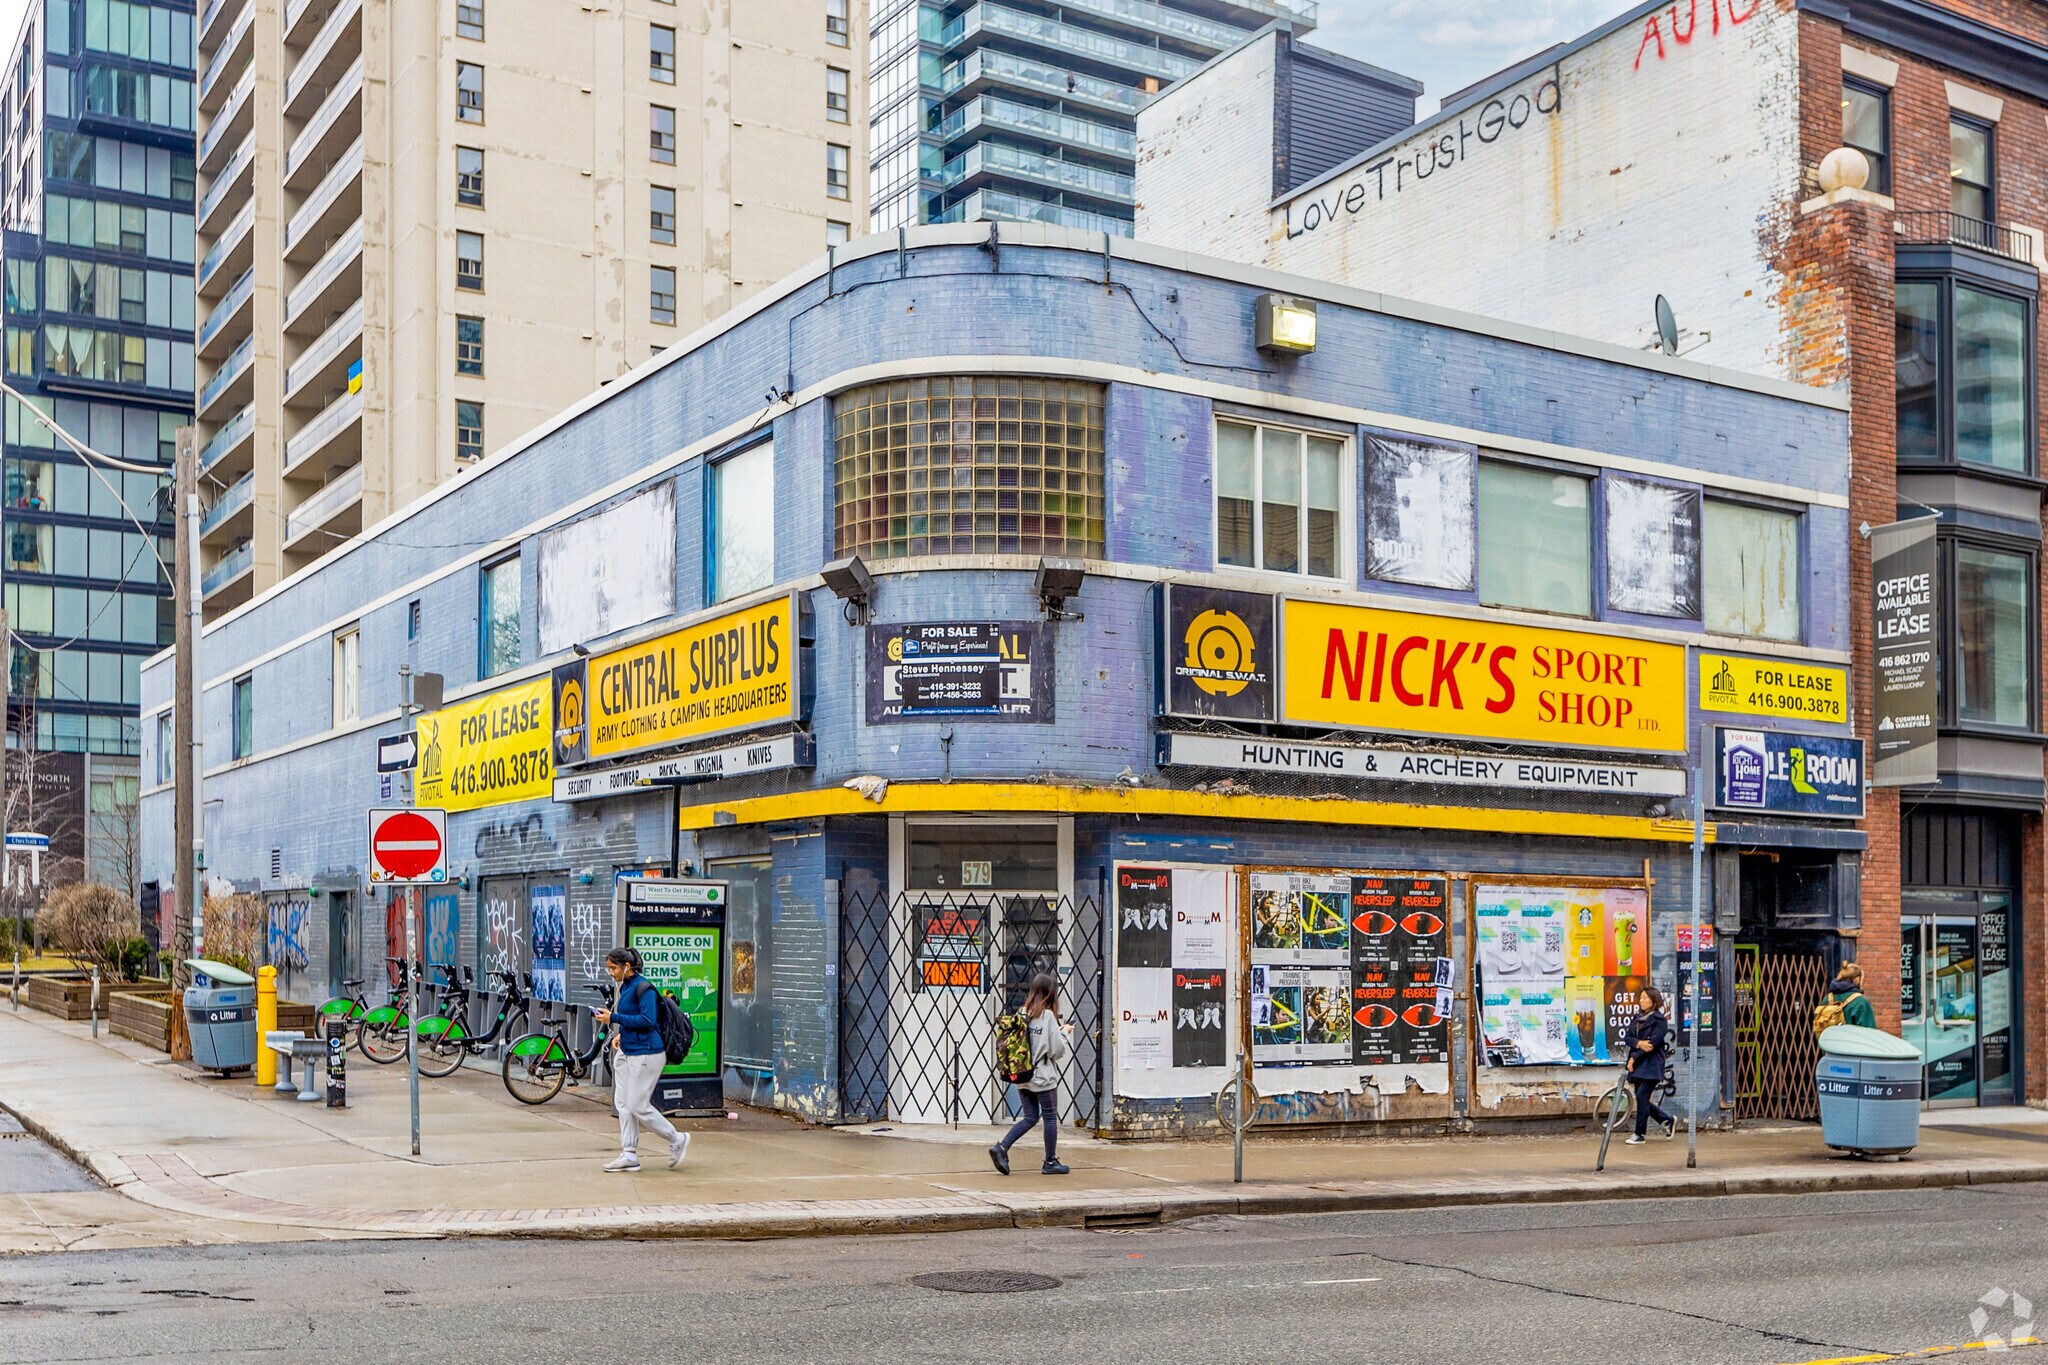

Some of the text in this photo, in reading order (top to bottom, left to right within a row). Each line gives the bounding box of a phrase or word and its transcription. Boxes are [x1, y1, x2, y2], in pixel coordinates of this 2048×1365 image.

[1877, 573, 1930, 597] OFFICE
[1877, 591, 1930, 611] AVAILABLE
[1896, 607, 1911, 618] FOR
[921, 626, 978, 638] FOR SALE
[1878, 613, 1930, 639] LEASE
[600, 615, 779, 716] CENTRAL SURPLUS
[1879, 651, 1930, 668] 416 862 1710
[903, 664, 985, 675] Steve Hennessey
[1175, 666, 1267, 682] ORIGINAL S.W.A.T.
[1320, 627, 1648, 714] NICK'S SPORT
[929, 682, 982, 691] 416-391-3232
[1755, 670, 1833, 692] FOR LEASE
[1709, 694, 1738, 706] PIVOTAL
[1748, 691, 1840, 716] 416.900.3878
[596, 726, 619, 744] ARMY
[621, 715, 658, 738] CLOTHING
[660, 714, 667, 728] &
[669, 704, 711, 727] CAMPING
[713, 682, 788, 717] HEADQUARTERS
[1537, 690, 1662, 733] SHOP LTD.
[460, 716, 487, 748] FOR
[491, 698, 541, 739] LEASE
[1894, 714, 1924, 724] CUSHMAN
[1894, 720, 1931, 730] WAKEFIELD
[450, 748, 550, 796] 416.900.3878
[567, 777, 592, 795] SECURITY
[693, 754, 724, 774] INSIGNIA
[746, 745, 773, 767] KNIVES
[1241, 744, 1639, 788] HUNTING & ARCHERY EQUIPMENT
[1735, 764, 1762, 780] HOME
[1806, 753, 1857, 787] ROOM
[38, 773, 71, 784] NORTH
[420, 784, 443, 803] PIVOTAL
[963, 862, 990, 884] 579
[1366, 880, 1383, 888] NAV
[1414, 881, 1430, 890] NAV
[629, 905, 646, 914] Yonge
[647, 905, 654, 913] St
[660, 905, 689, 914] Dundonald
[690, 906, 697, 914] St
[943, 911, 963, 920] FOR
[1981, 914, 2005, 925] OFFICE
[927, 919, 979, 935] RENT
[1982, 925, 2004, 935] SPACE
[635, 936, 711, 947] EXPLORE ON
[671, 952, 701, 962] OWN
[1981, 949, 2006, 960] LEASE
[642, 967, 679, 977] ERMS
[924, 962, 980, 986] FOR SALE
[1366, 973, 1383, 981] NAV
[1414, 973, 1430, 981] NAV
[1615, 993, 1635, 1002] GET
[219, 1010, 237, 1020] Litter
[1610, 1005, 1640, 1015] YOUR
[1609, 1017, 1633, 1027] GLO
[1829, 1082, 1883, 1096] Litter Litter
